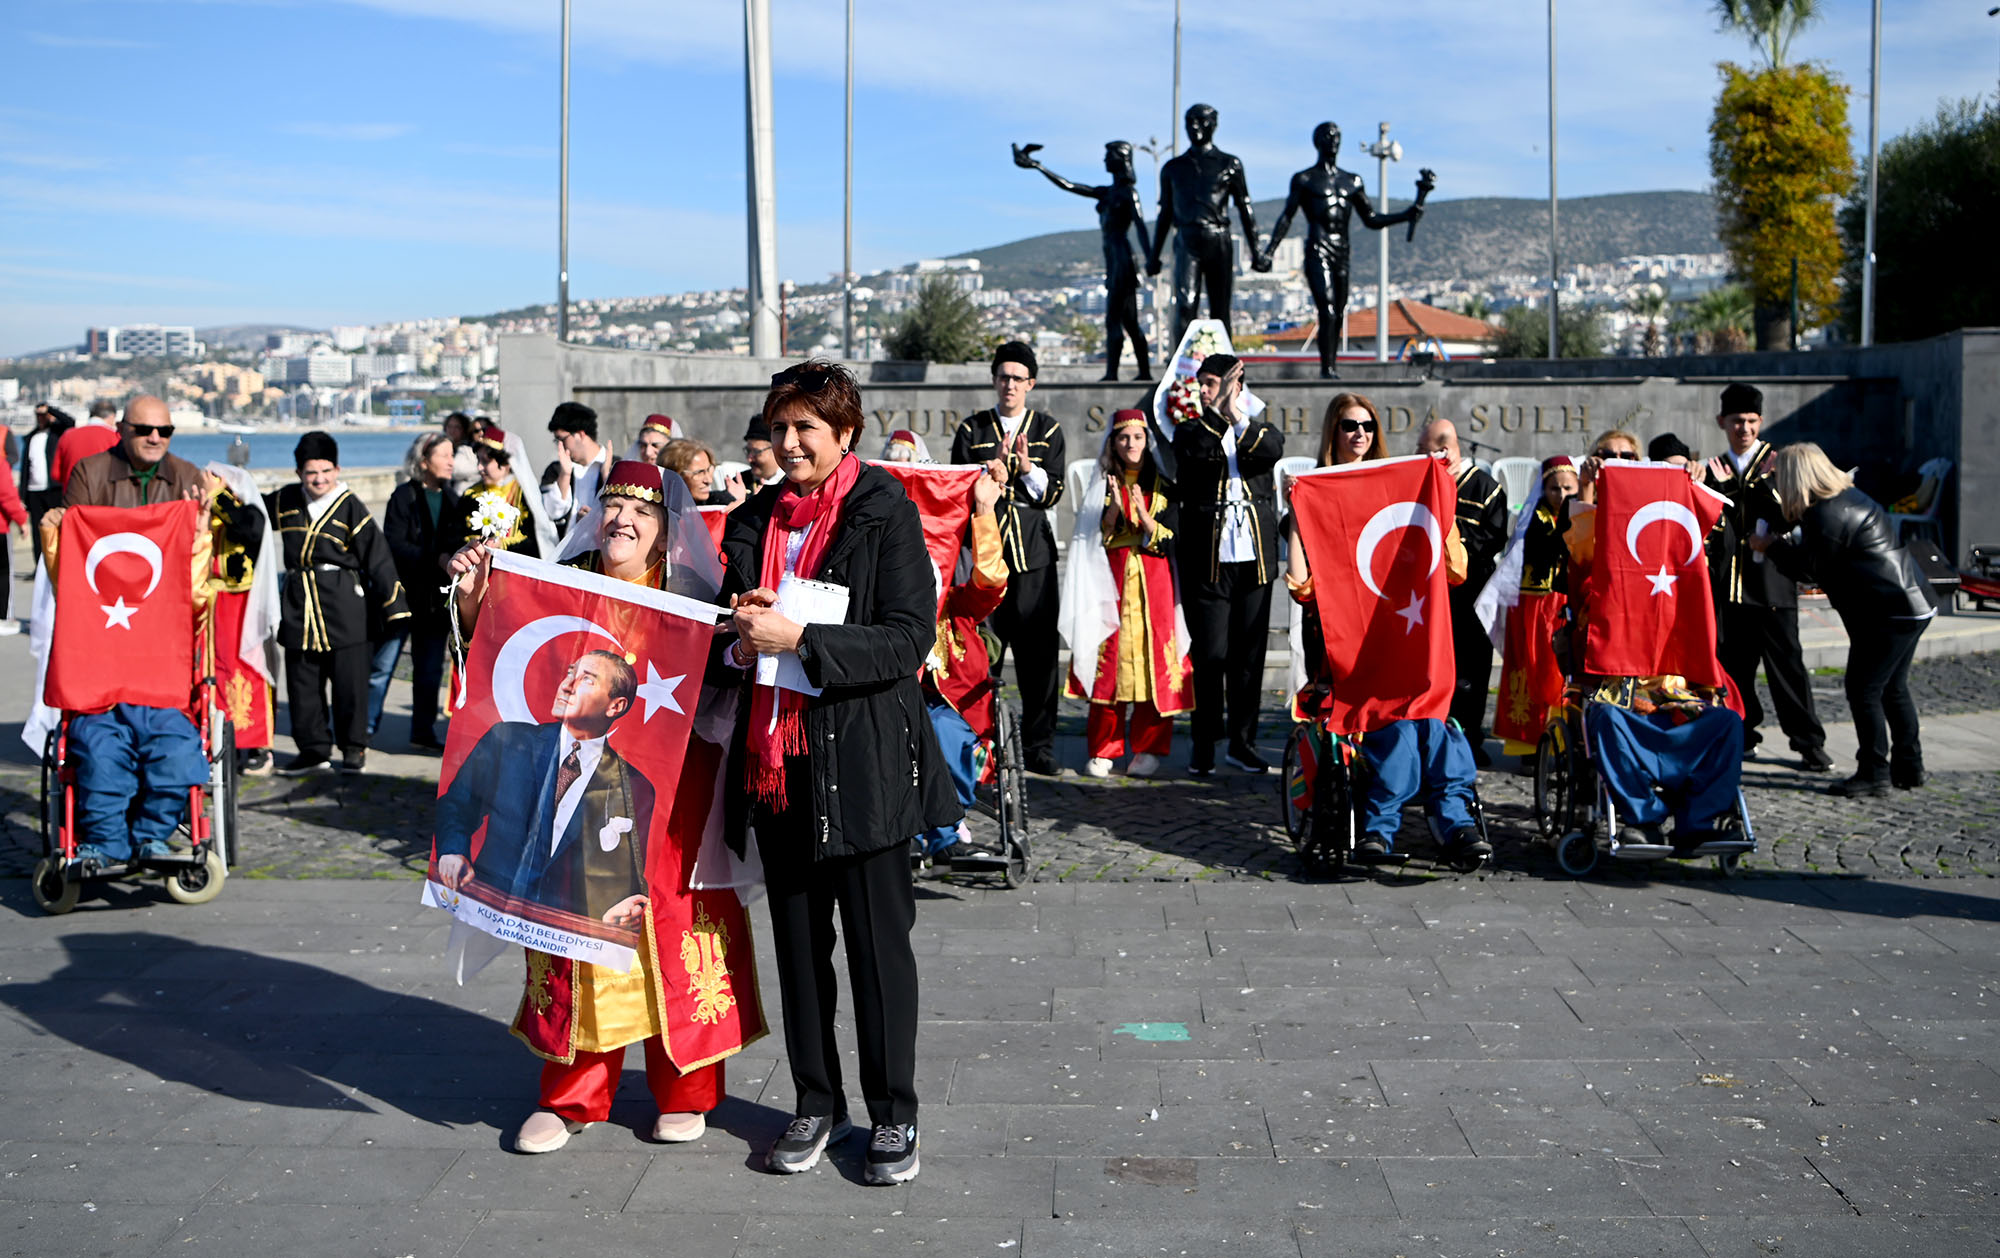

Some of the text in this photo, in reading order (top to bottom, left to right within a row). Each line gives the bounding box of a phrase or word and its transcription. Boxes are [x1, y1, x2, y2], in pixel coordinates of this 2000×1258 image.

[1470, 404, 1591, 434] SULH
[477, 906, 604, 951] KUŞADASI BELEDİYESİ
